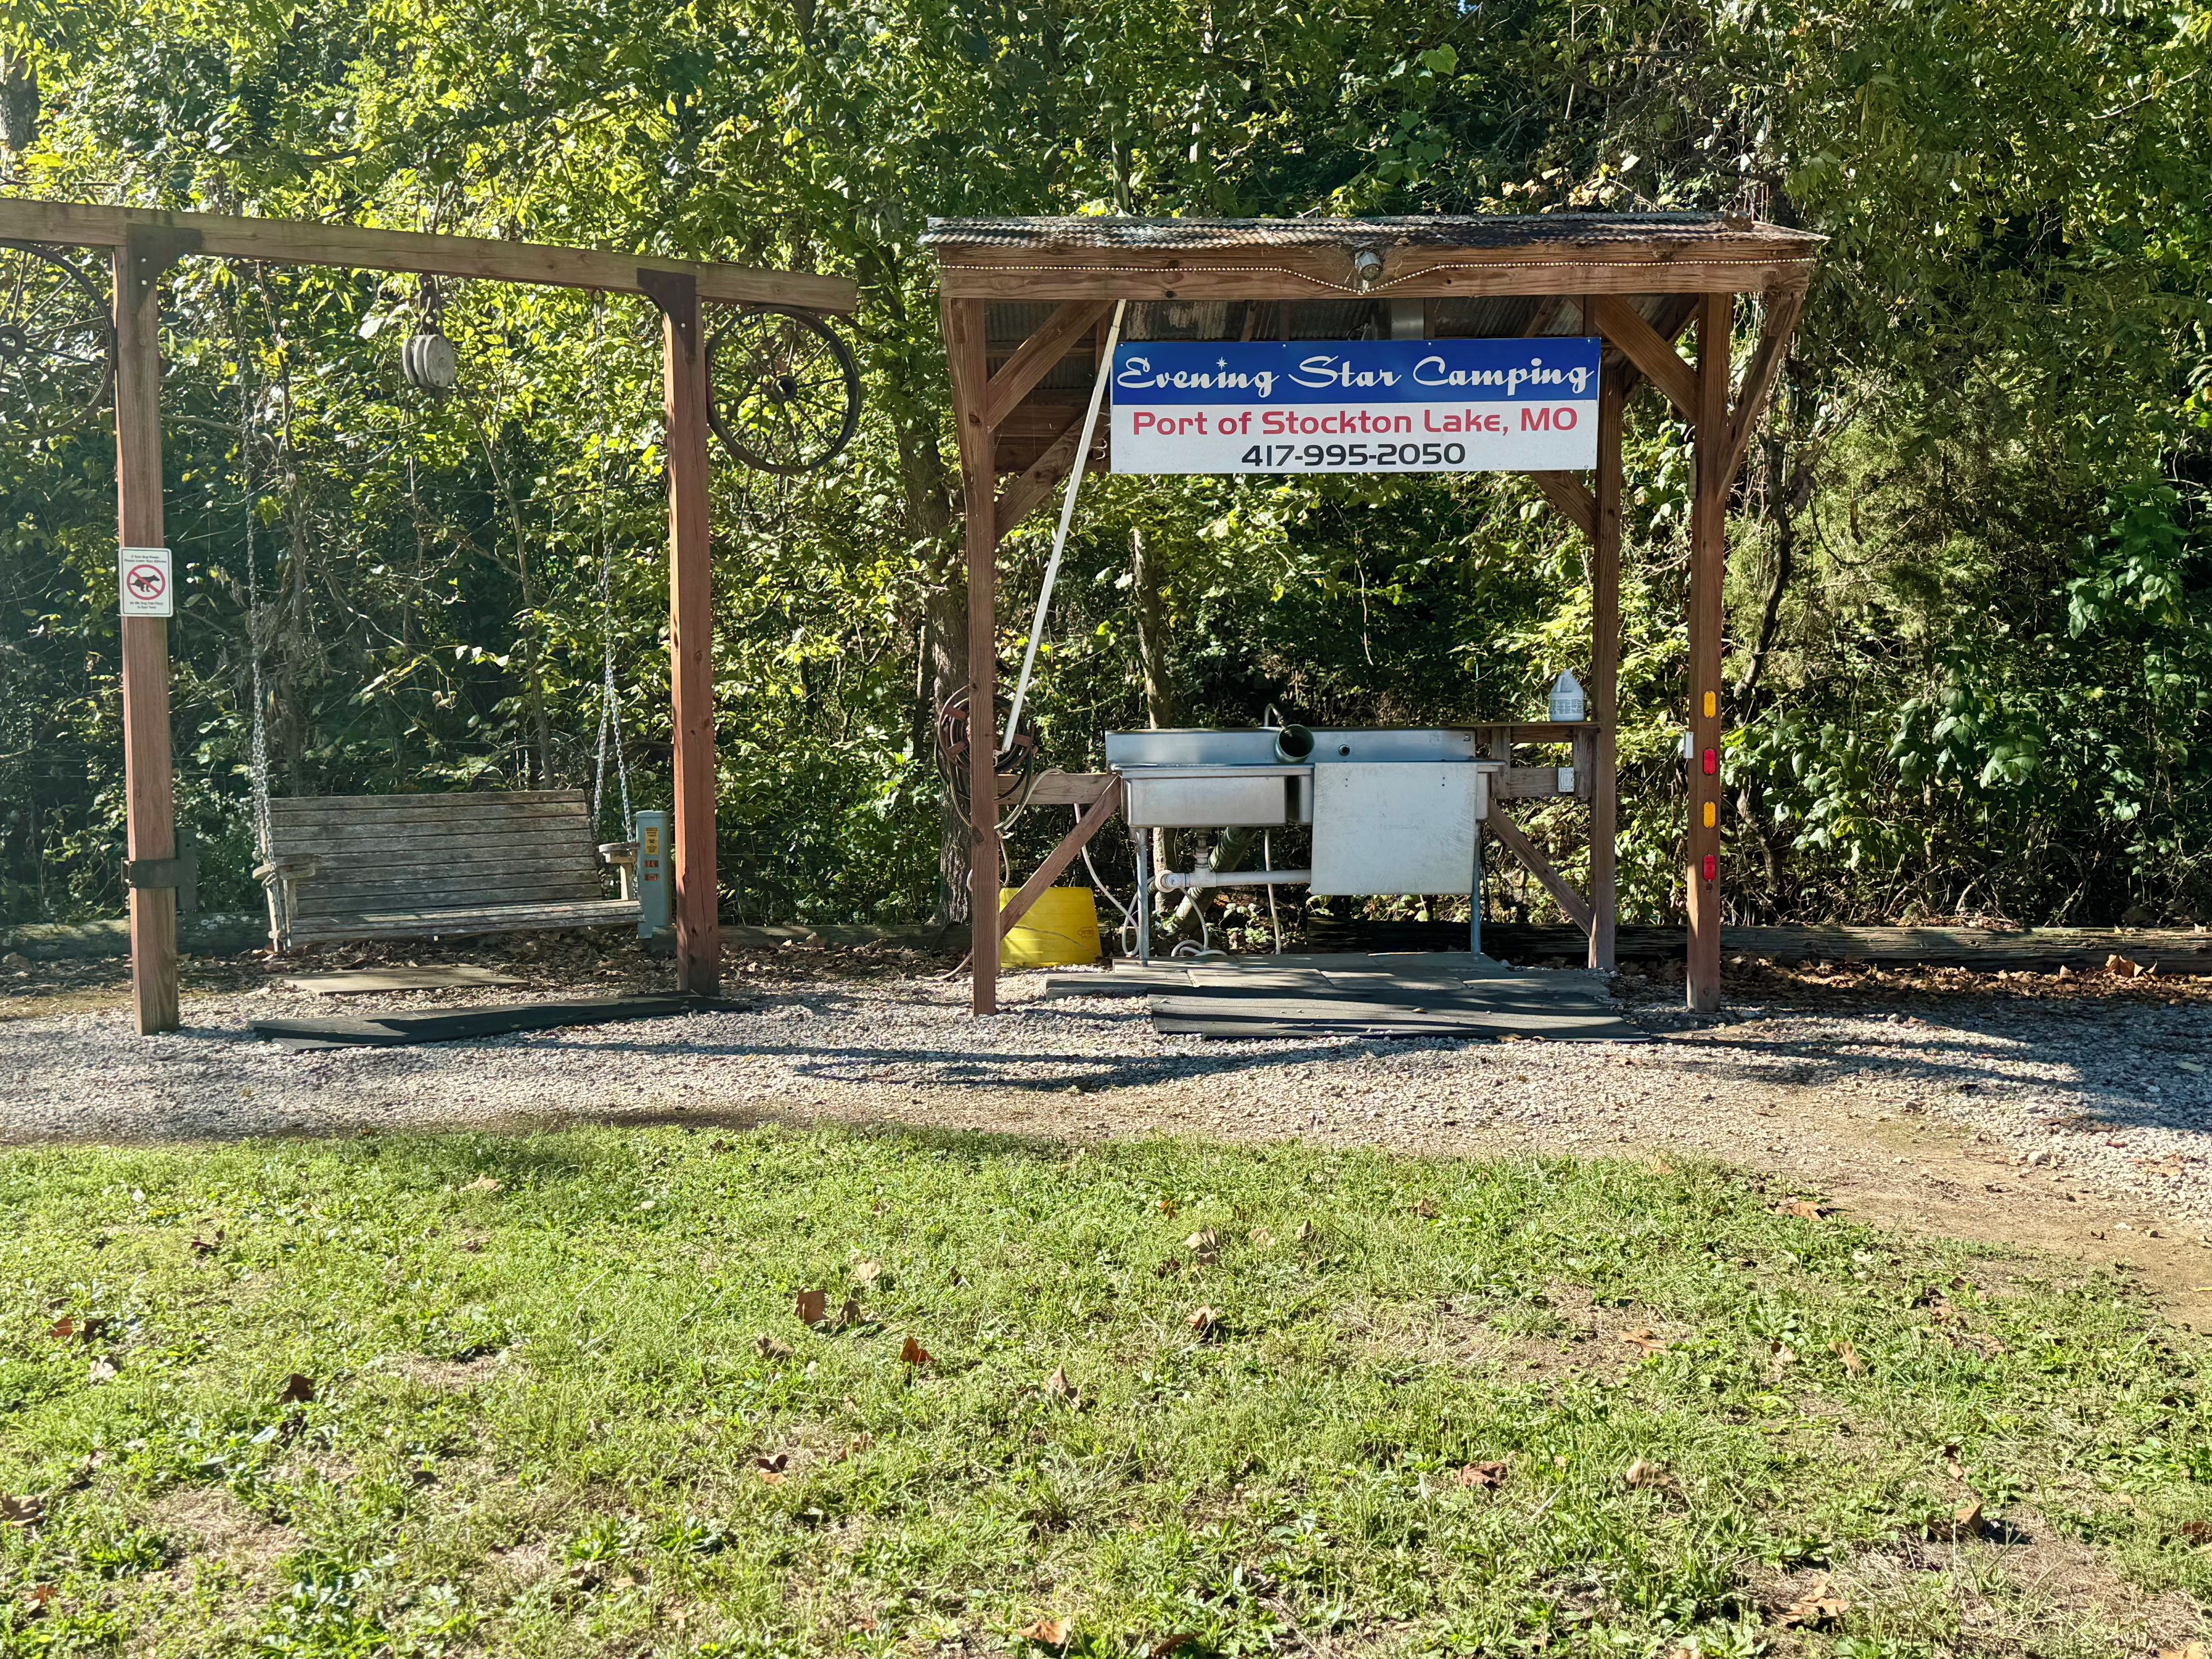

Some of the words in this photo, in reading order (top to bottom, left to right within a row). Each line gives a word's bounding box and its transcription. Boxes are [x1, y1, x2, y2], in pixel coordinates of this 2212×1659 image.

[1117, 356, 1280, 398] Evening
[1288, 355, 1402, 388] Star
[1413, 356, 1595, 396] Camping
[1133, 411, 1208, 435] Port
[1218, 411, 1252, 435] of
[1262, 410, 1412, 435] Stockton
[1424, 408, 1509, 437] Lake,
[1521, 407, 1578, 431] MO
[1241, 442, 1465, 467] 417-995-2050
